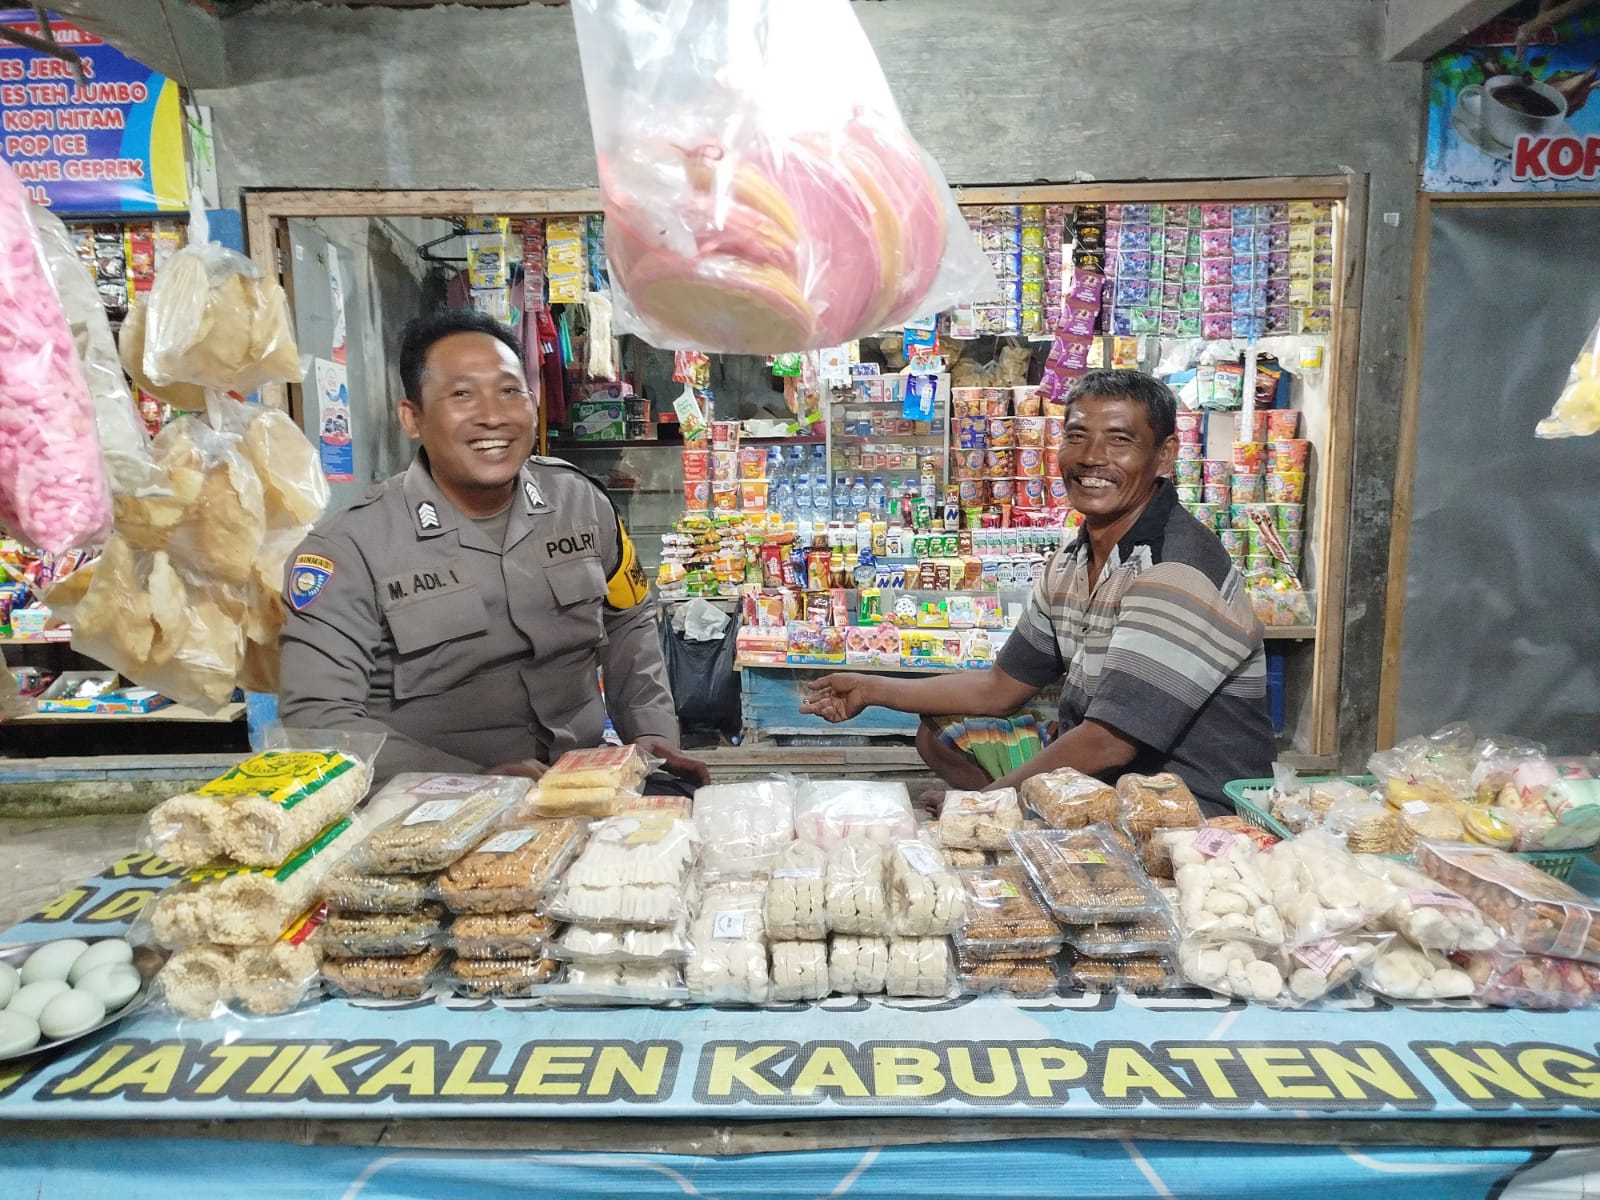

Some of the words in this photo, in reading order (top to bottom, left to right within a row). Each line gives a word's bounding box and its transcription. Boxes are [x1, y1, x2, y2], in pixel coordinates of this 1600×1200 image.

[0, 60, 23, 79] ES
[2, 86, 26, 105] ES
[27, 85, 68, 104] TEH
[73, 82, 148, 104] JUMBO
[3, 110, 54, 131] KOPI
[57, 109, 125, 130] HITAM
[6, 137, 50, 156] POP
[54, 135, 88, 155] ICE
[64, 159, 145, 180] GEPREK
[546, 533, 595, 558] POLRI
[388, 580, 408, 601] M.
[50, 1043, 672, 1097] JATIKALEN
[706, 1045, 1420, 1100] KABUPATEN
